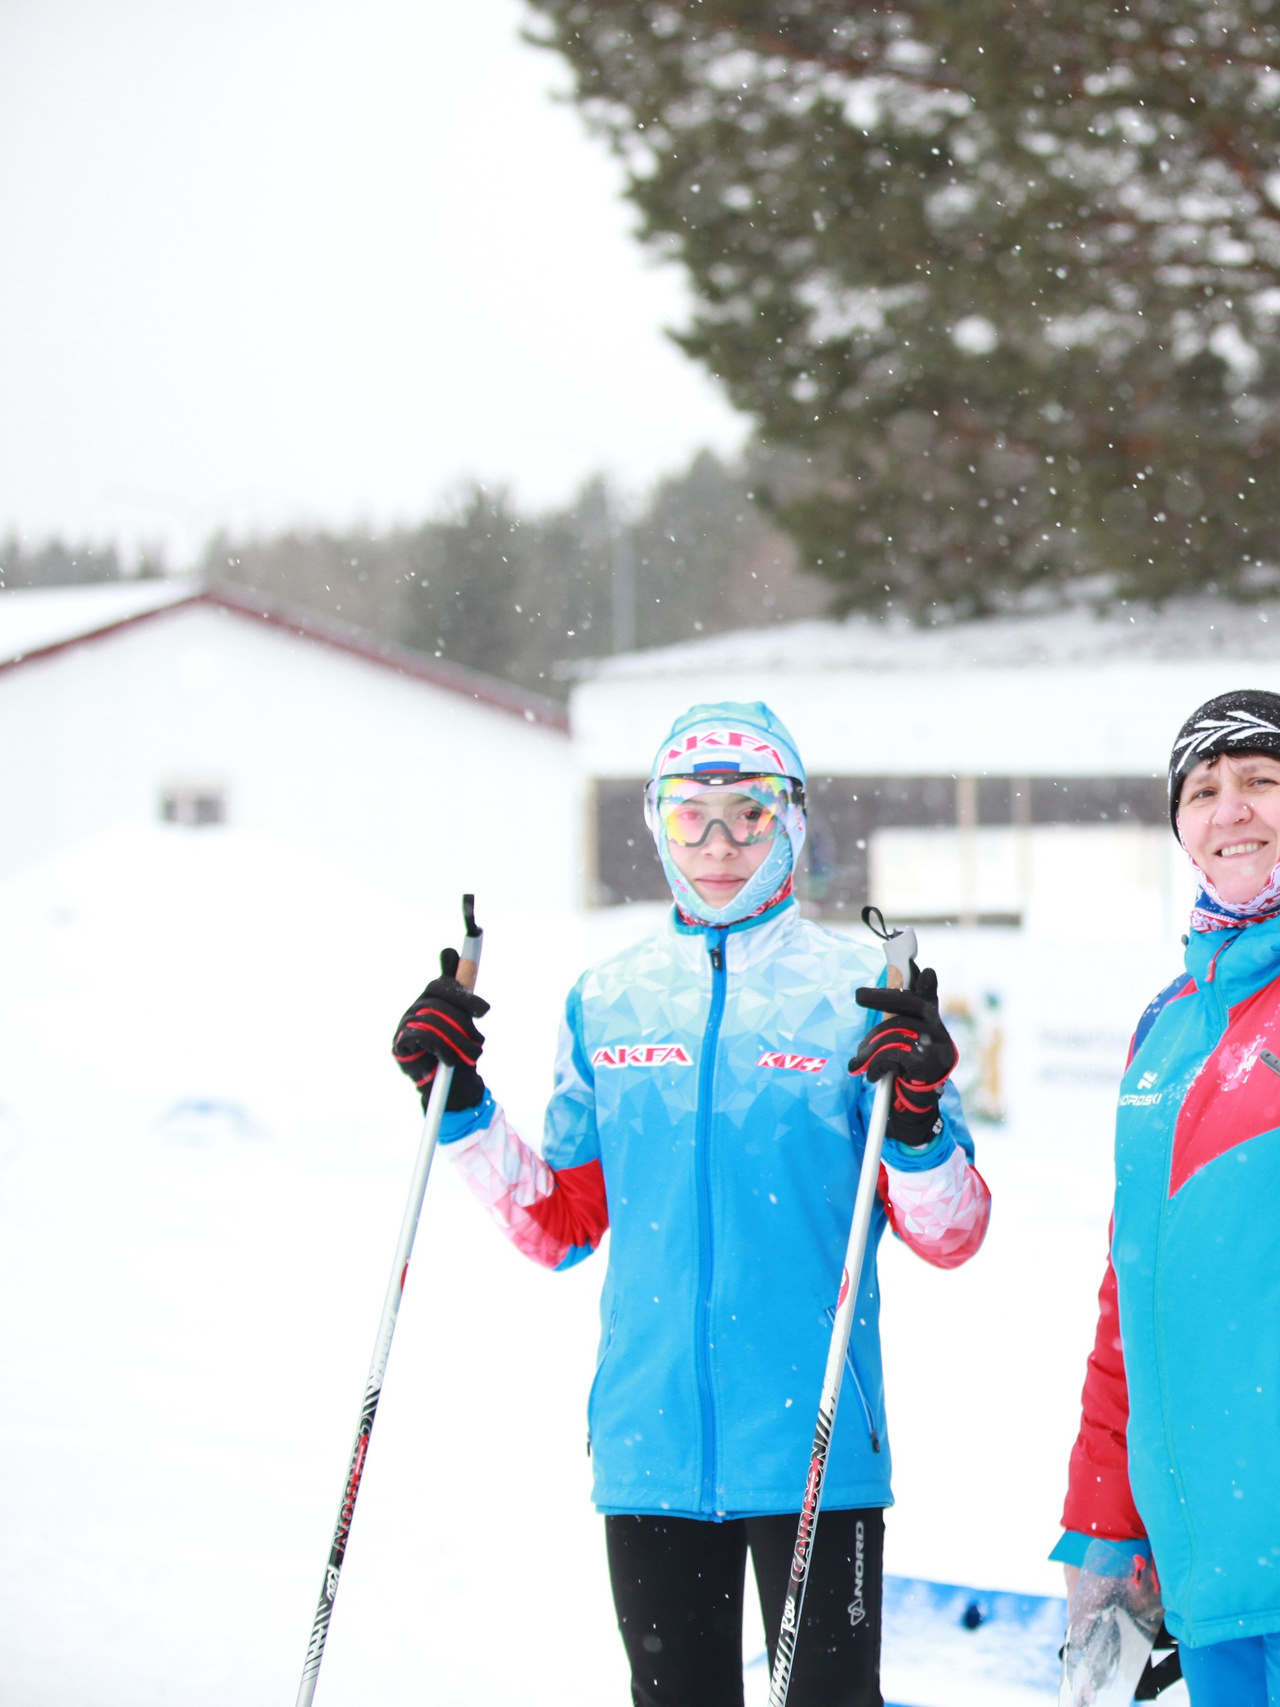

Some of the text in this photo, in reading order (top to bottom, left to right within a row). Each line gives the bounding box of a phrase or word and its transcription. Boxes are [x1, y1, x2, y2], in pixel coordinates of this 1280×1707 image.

[657, 729, 788, 776] AKFA
[592, 1044, 693, 1067] AKFA
[757, 1052, 826, 1072] KV+
[1119, 1093, 1163, 1106] ORDSKI
[780, 1438, 828, 1635] Rex CARBON
[854, 1521, 864, 1598] NORD
